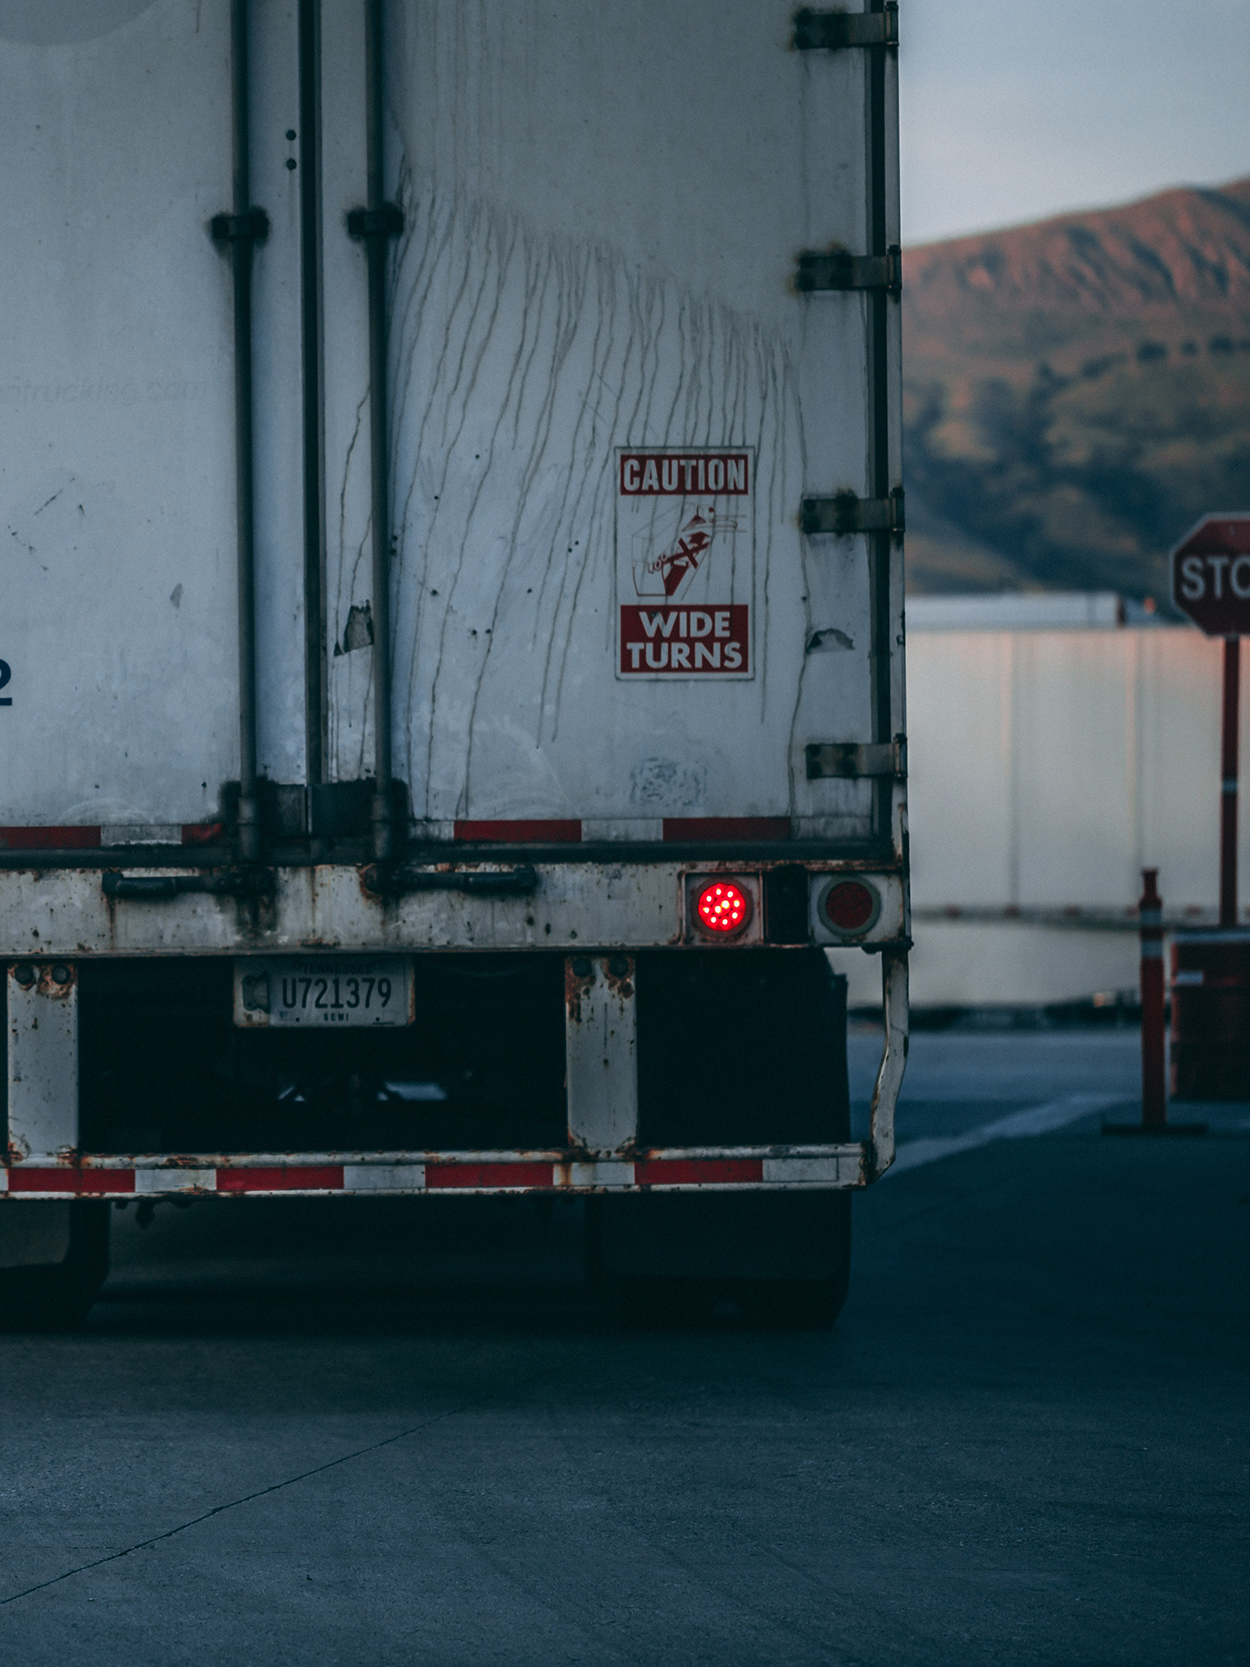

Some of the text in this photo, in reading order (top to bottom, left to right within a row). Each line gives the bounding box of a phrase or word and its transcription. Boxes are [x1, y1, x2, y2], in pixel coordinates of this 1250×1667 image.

[623, 458, 745, 491] CAUTION
[638, 611, 730, 637] WIDE
[626, 642, 743, 668] TURNS
[282, 978, 392, 1008] U721379
[323, 1012, 349, 1021] SEMI
